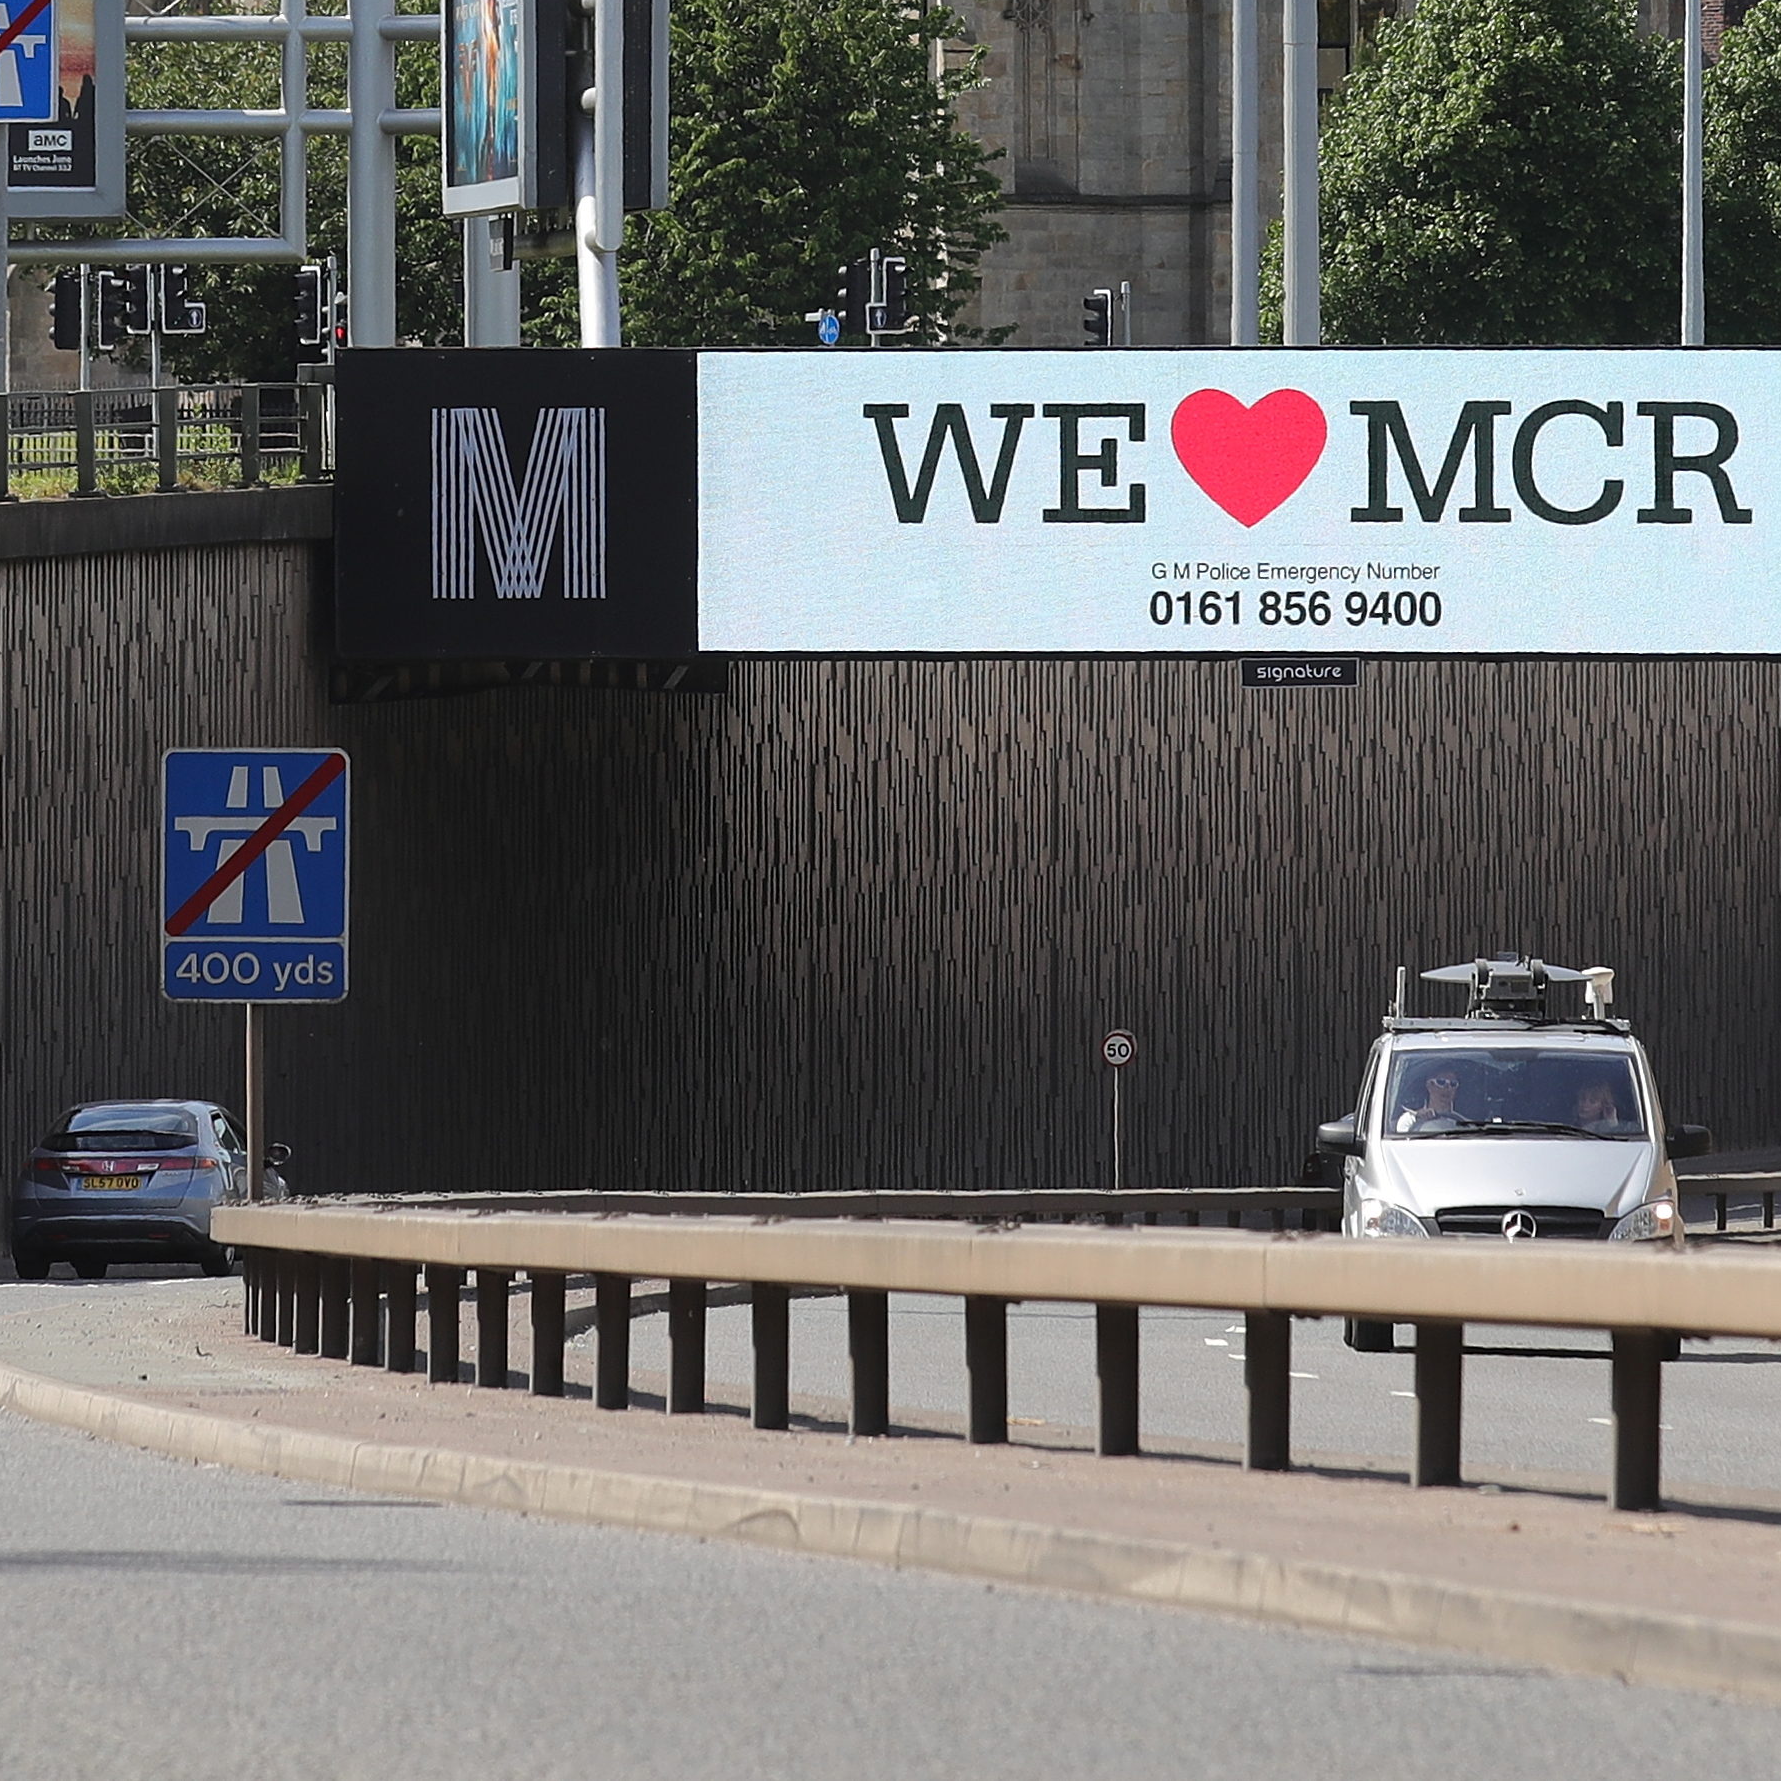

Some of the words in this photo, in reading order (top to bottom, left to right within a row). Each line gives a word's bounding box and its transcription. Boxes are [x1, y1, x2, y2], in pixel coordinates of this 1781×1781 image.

[862, 402, 1147, 525] WE
[1349, 399, 1754, 525] MCR
[431, 407, 607, 600] M
[1151, 562, 1167, 580] G
[1173, 562, 1191, 580] M
[1196, 562, 1250, 580] Police
[1257, 562, 1361, 584] Emergency
[1367, 562, 1441, 580] Number
[1149, 590, 1241, 626] 0161
[1258, 590, 1332, 626] 856
[1344, 590, 1442, 626] 9400
[1256, 664, 1343, 683] signature
[175, 951, 261, 985] 400
[272, 954, 334, 992] yds
[1107, 1043, 1130, 1058] 50
[83, 1177, 114, 1189] SL57
